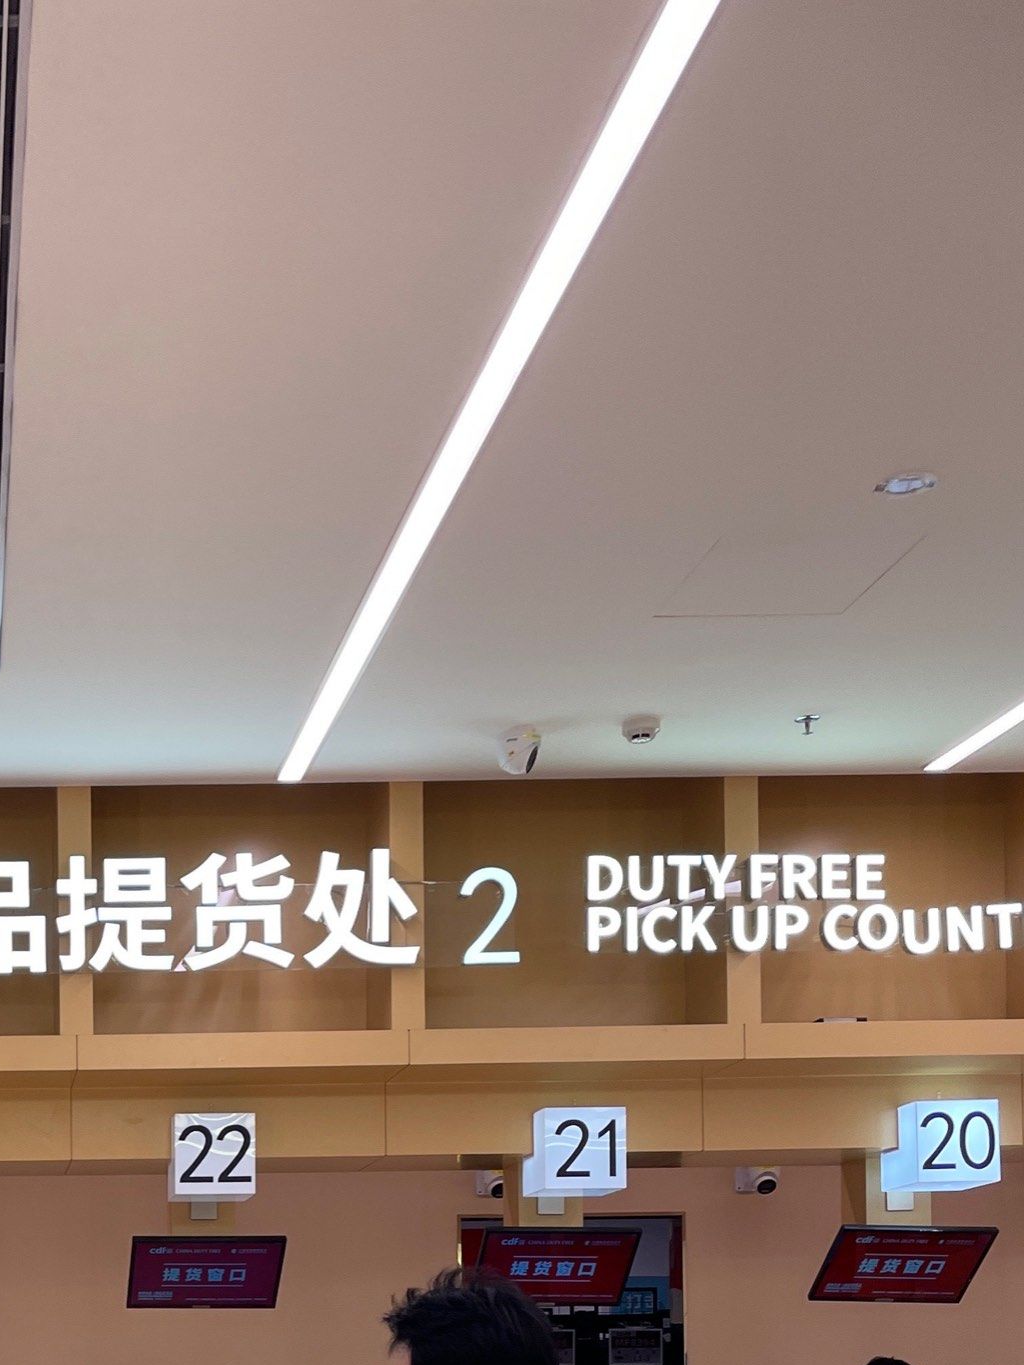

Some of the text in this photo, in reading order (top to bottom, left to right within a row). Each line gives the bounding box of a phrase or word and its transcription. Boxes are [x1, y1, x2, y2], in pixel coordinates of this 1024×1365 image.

[587, 854, 885, 901] DUTY FREE
[459, 867, 521, 966] 2
[586, 903, 1024, 956] PICK UP COUNT
[177, 1125, 253, 1183] 22
[555, 1119, 618, 1177] 21
[919, 1111, 996, 1169] 20
[162, 1267, 246, 1281] 提货窗口
[510, 1261, 597, 1276] 提货窗口
[857, 1258, 946, 1274] 提货窗口
